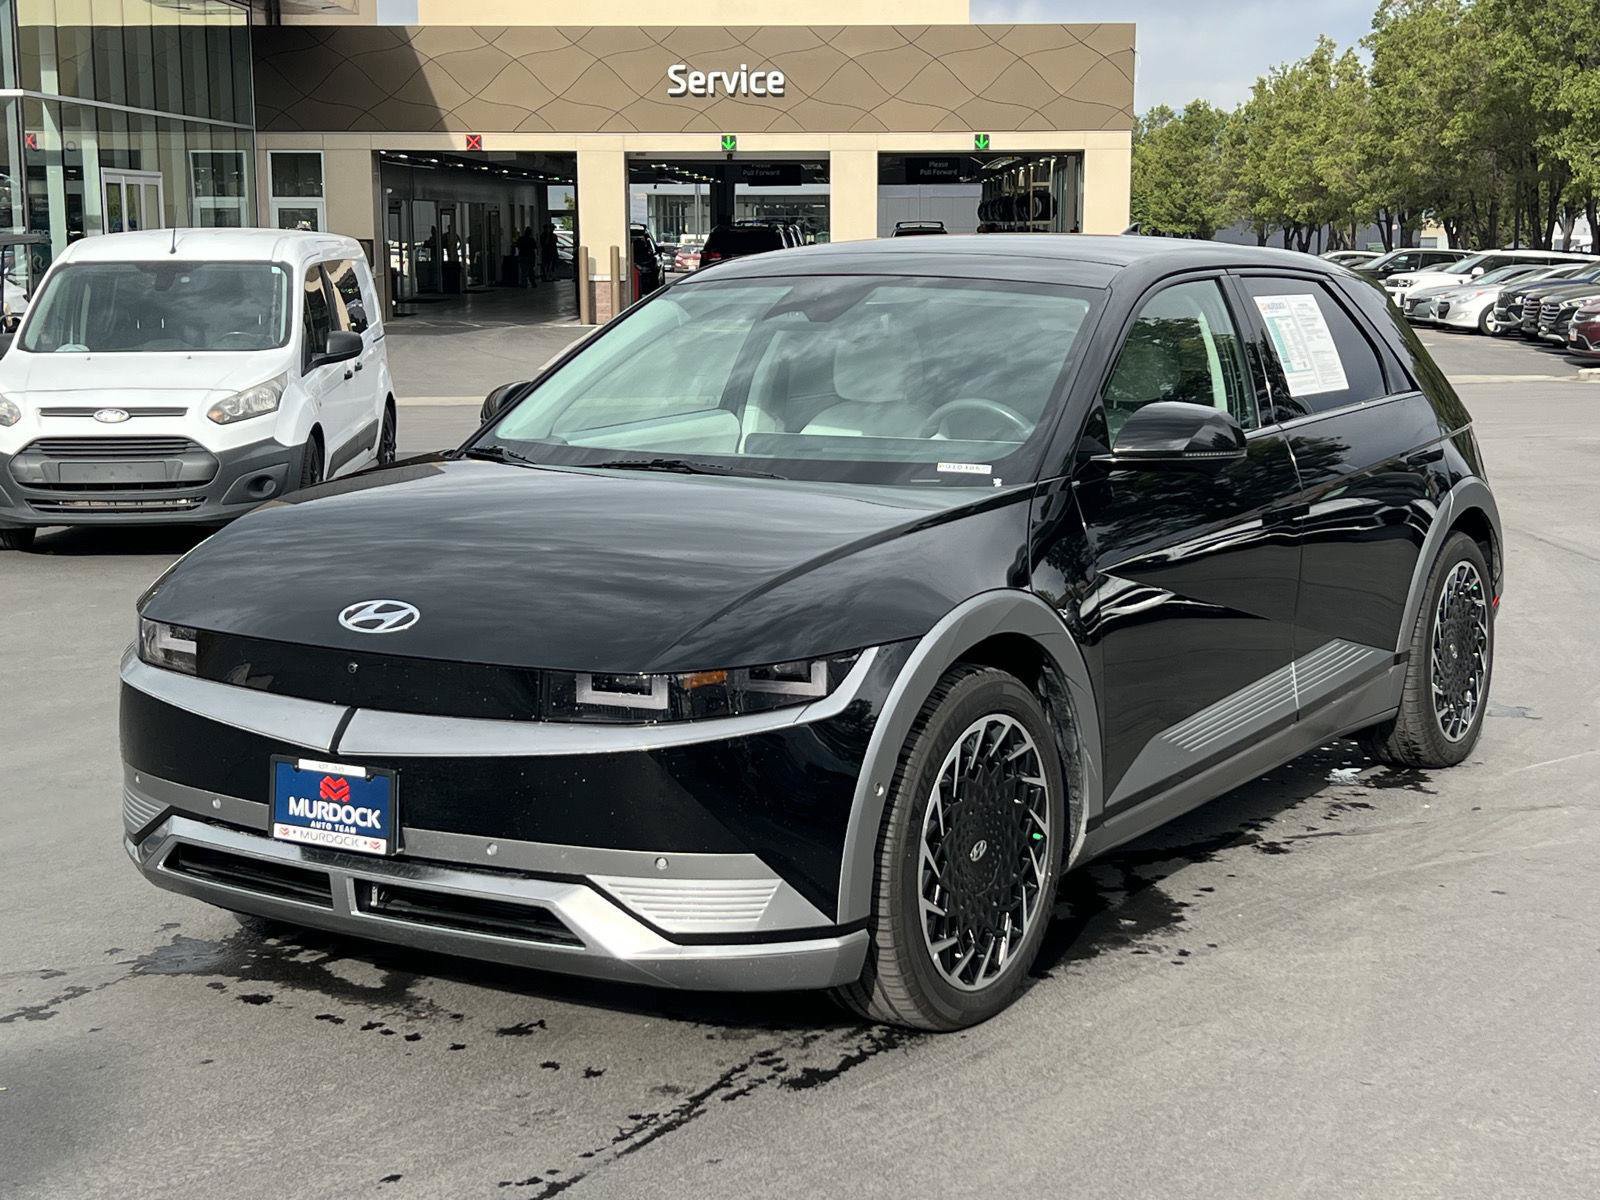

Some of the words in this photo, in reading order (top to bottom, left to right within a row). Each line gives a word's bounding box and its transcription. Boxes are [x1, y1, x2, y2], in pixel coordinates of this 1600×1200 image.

[667, 63, 785, 96] Service
[288, 796, 381, 829] MURDOCK
[299, 830, 360, 847] MURDOCK
[310, 820, 333, 830] AUTO
[334, 823, 357, 834] TEAM
